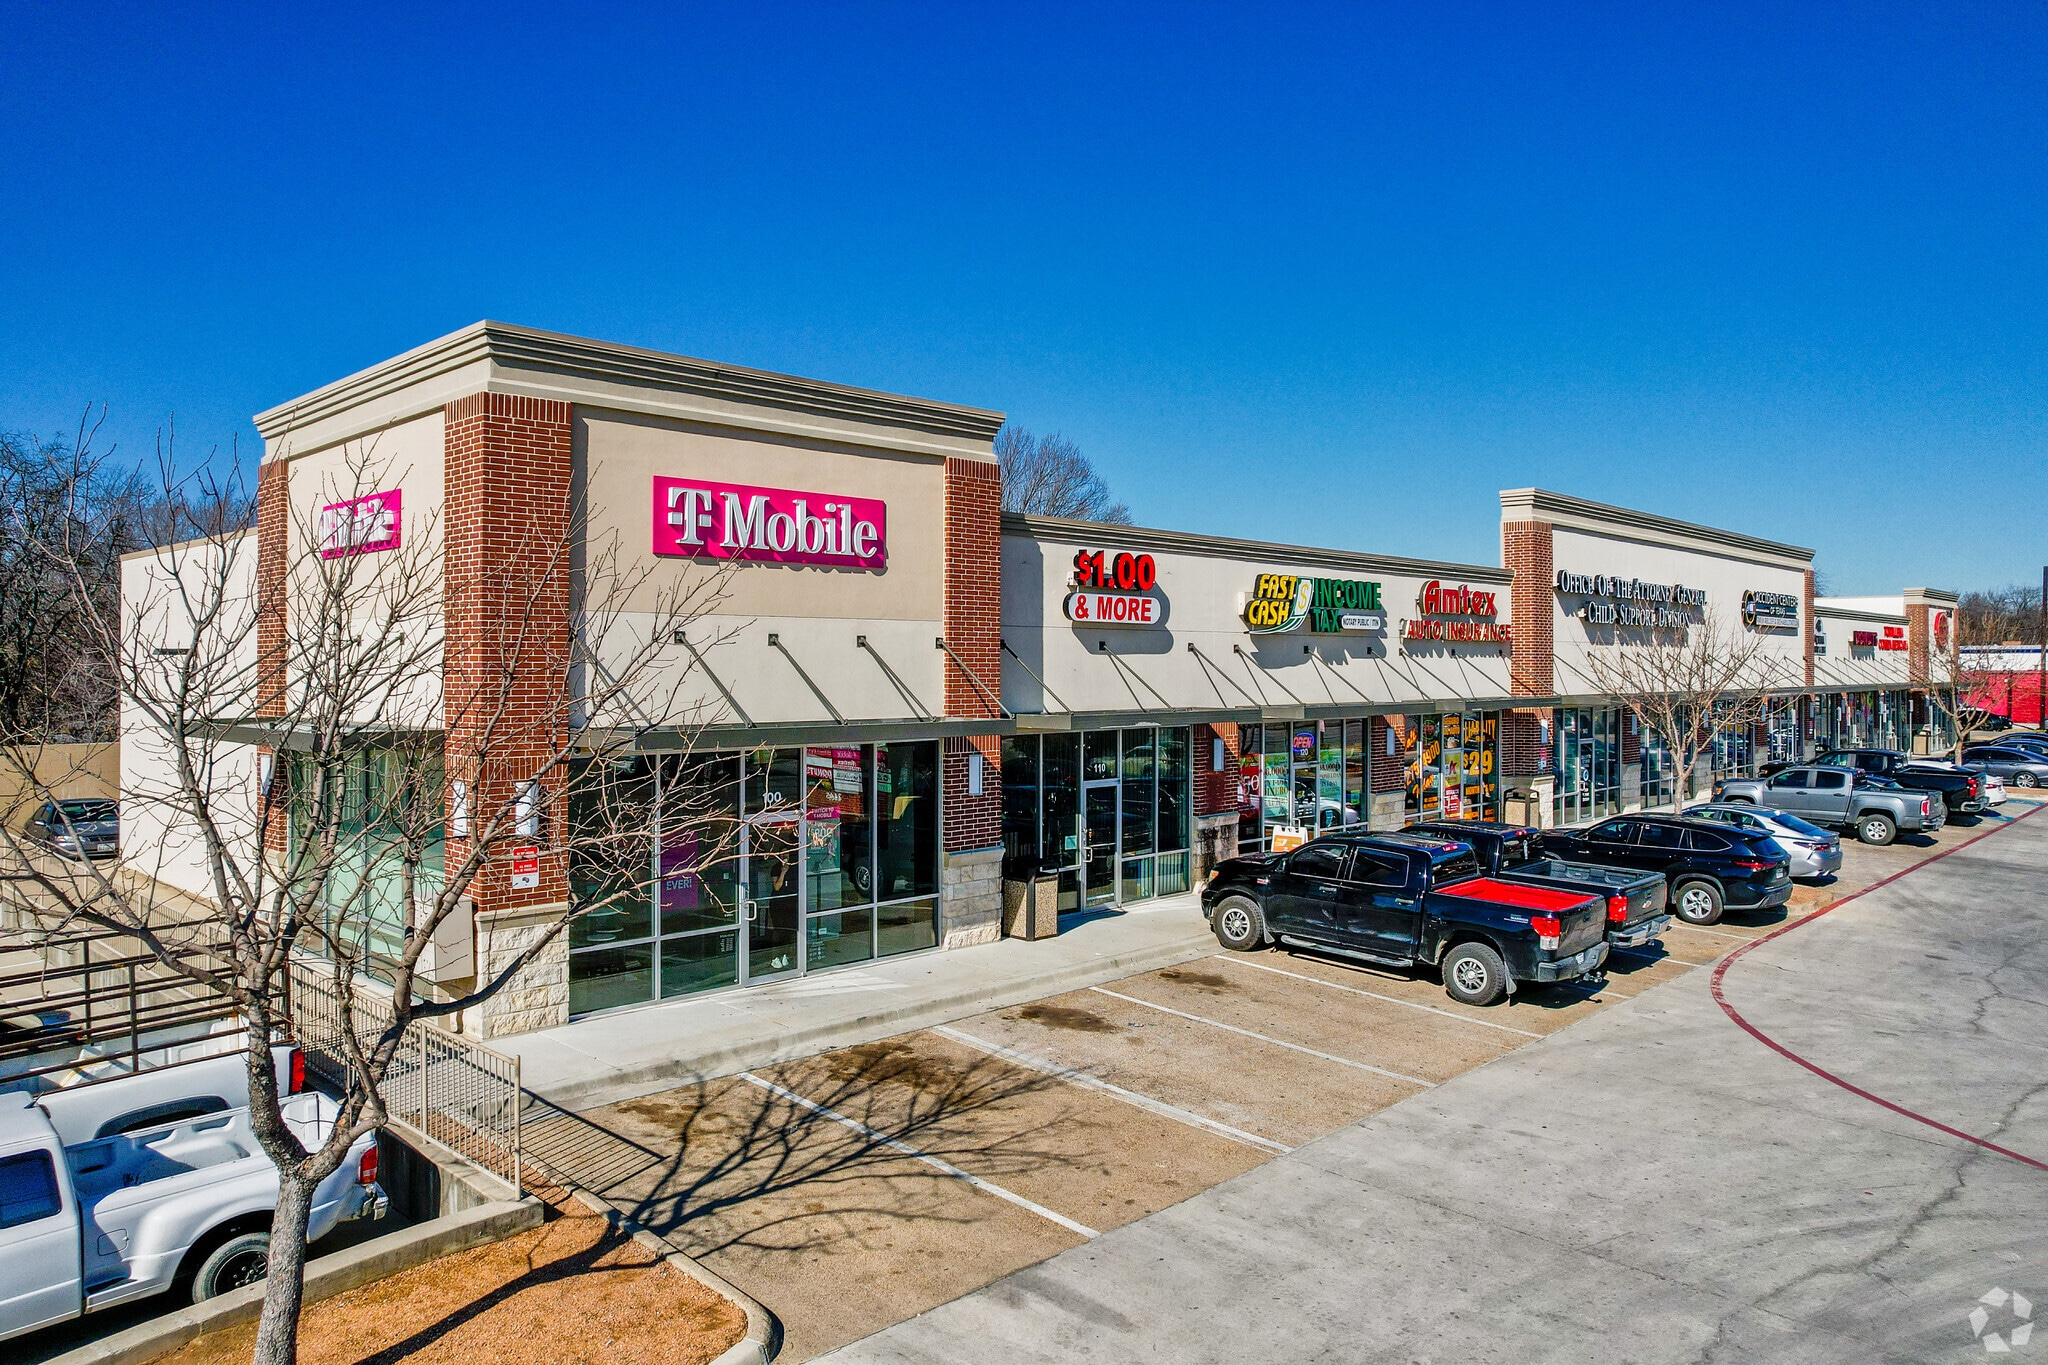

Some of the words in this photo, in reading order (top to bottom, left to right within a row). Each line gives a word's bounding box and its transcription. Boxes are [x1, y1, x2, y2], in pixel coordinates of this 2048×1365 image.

[720, 491, 878, 559] Mobile
[1074, 549, 1156, 591] $1.00
[1256, 573, 1298, 600] FAST
[1314, 578, 1382, 610] INCOME
[1423, 580, 1497, 616] Amtex
[1075, 595, 1090, 619] &
[1097, 596, 1152, 622] MORE
[1248, 600, 1290, 625] CASH
[1312, 608, 1341, 632] TAX
[1406, 620, 1442, 640] AUTO
[1446, 621, 1512, 643] INSURANCE
[1292, 736, 1312, 749] OPEN
[1464, 719, 1496, 744] LIABLITY
[1093, 763, 1106, 774] 110
[762, 791, 782, 803] 100
[666, 877, 693, 891] EVER!
